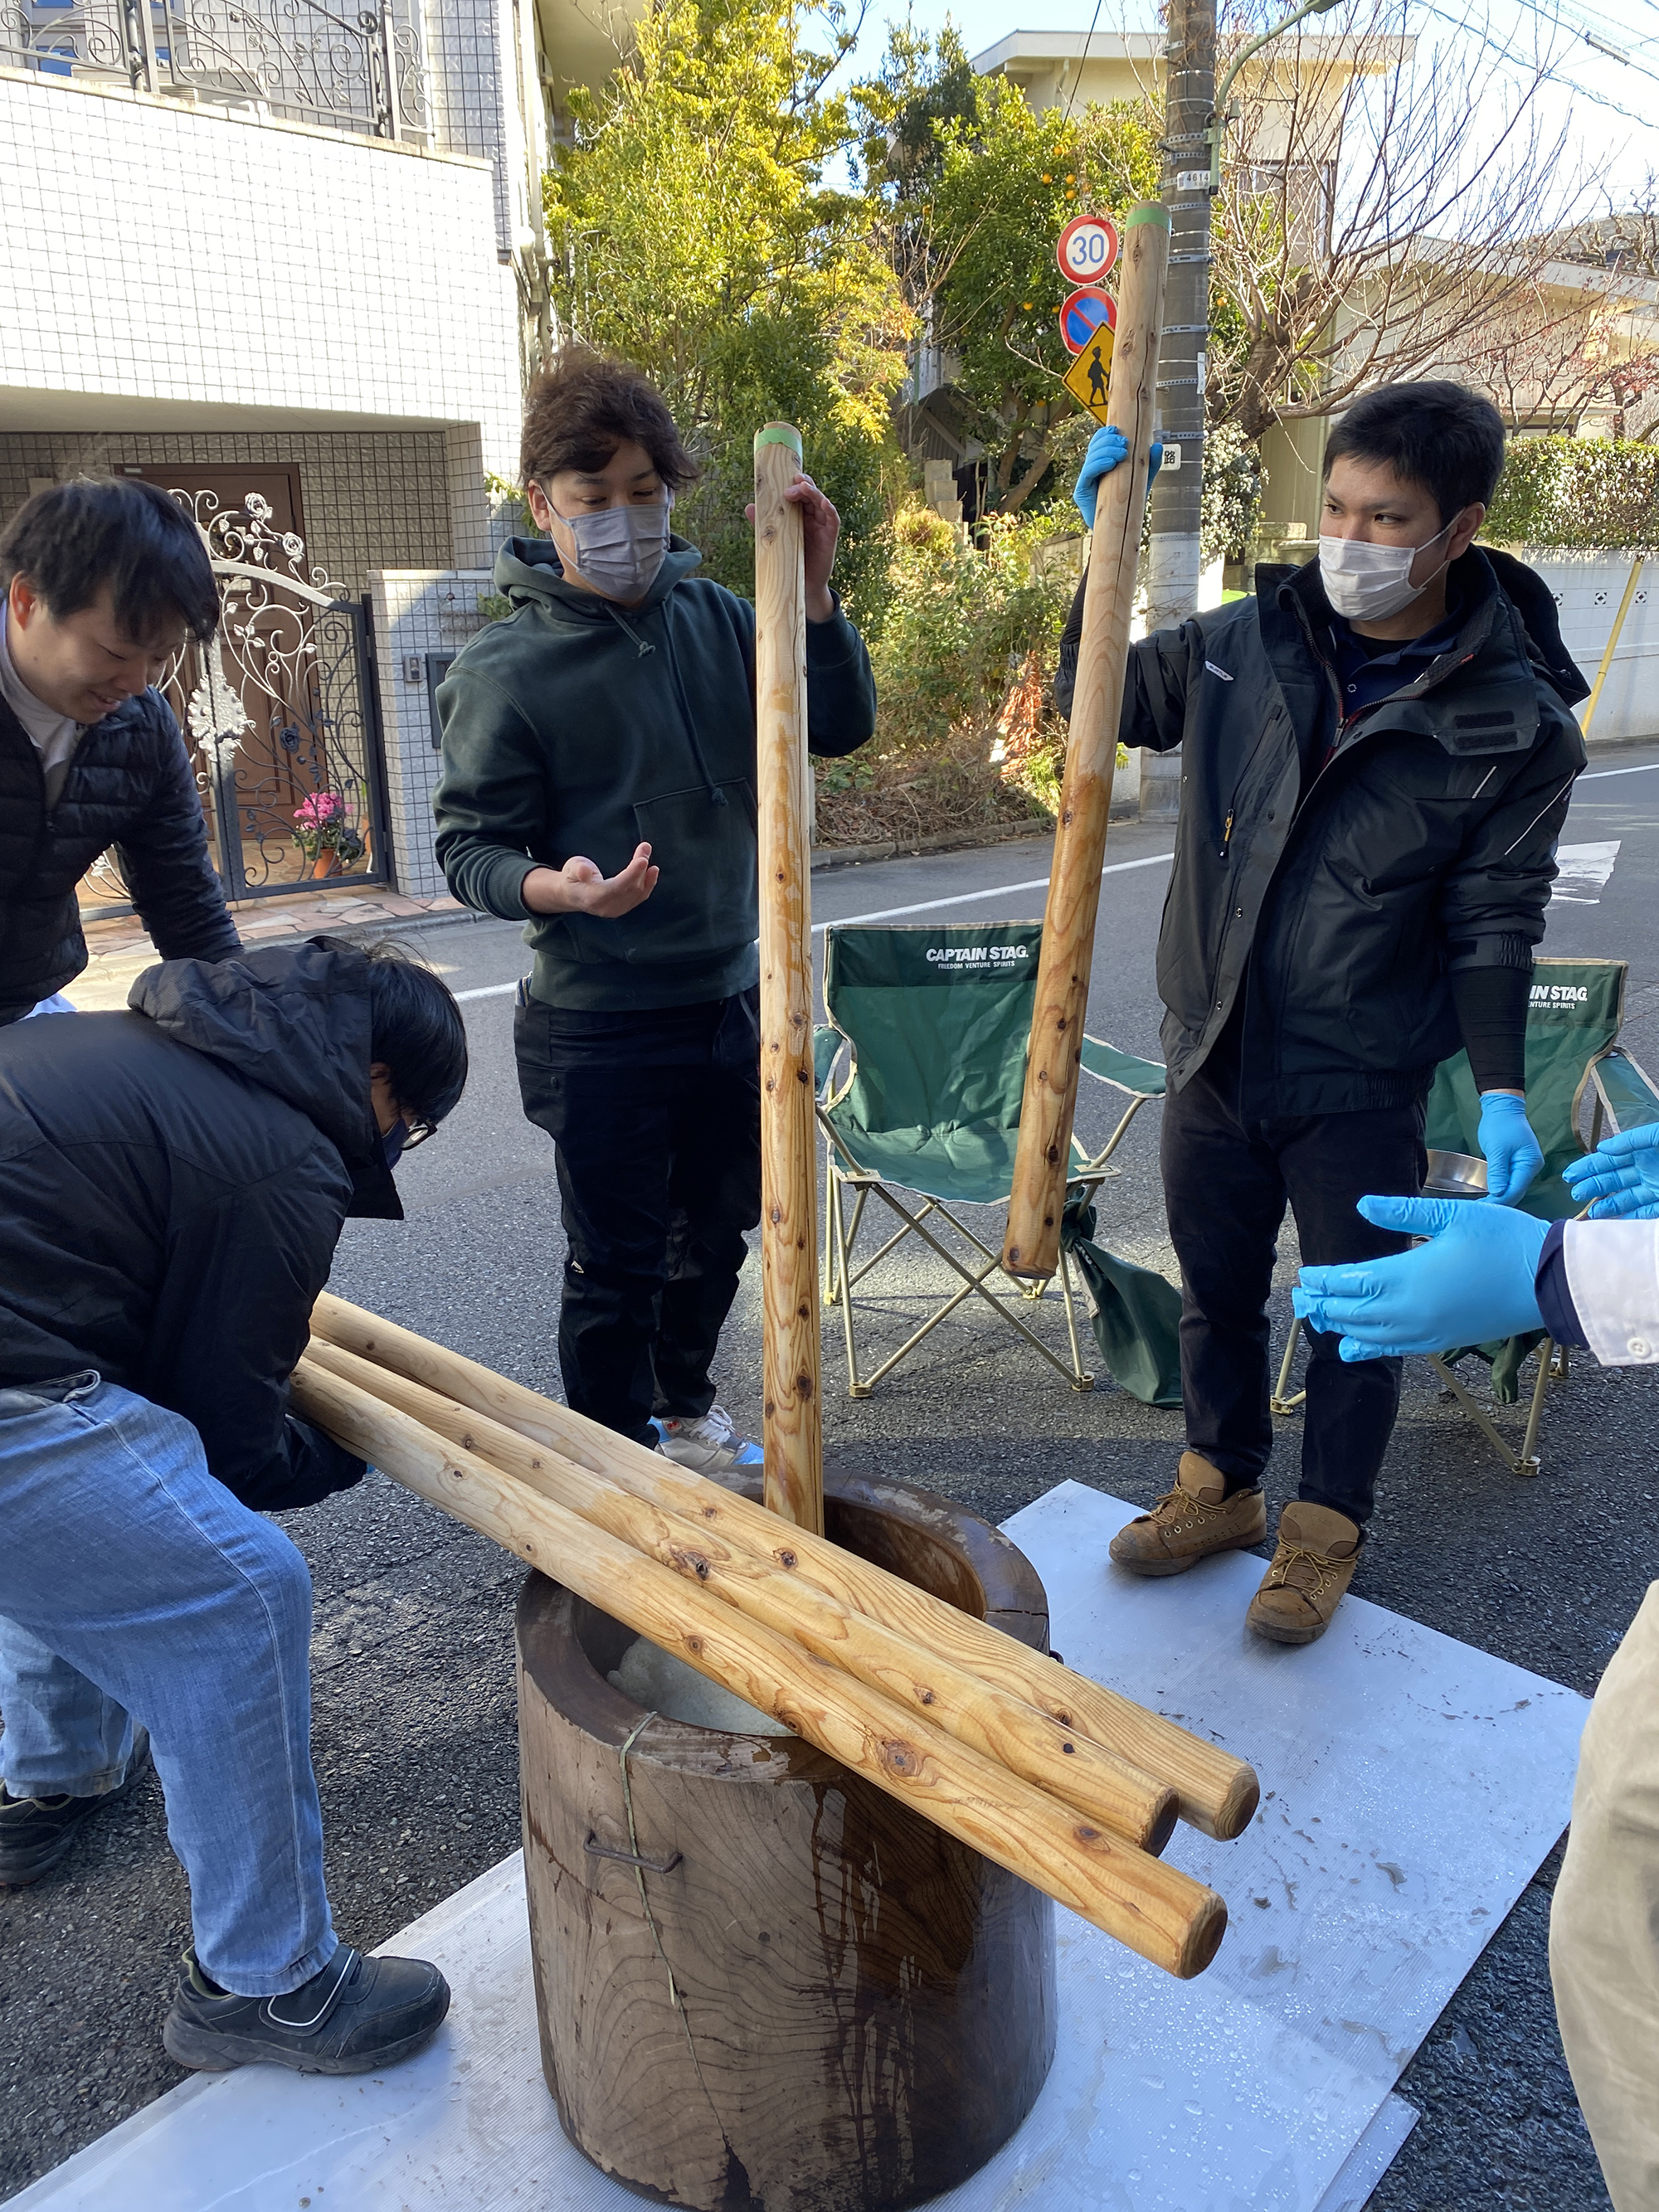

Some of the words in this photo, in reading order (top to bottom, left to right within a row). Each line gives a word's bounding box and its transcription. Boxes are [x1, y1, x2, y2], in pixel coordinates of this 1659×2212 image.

[1186, 173, 1209, 182] 4614
[1072, 233, 1104, 265] 30
[926, 947, 987, 962] CAPTAIN
